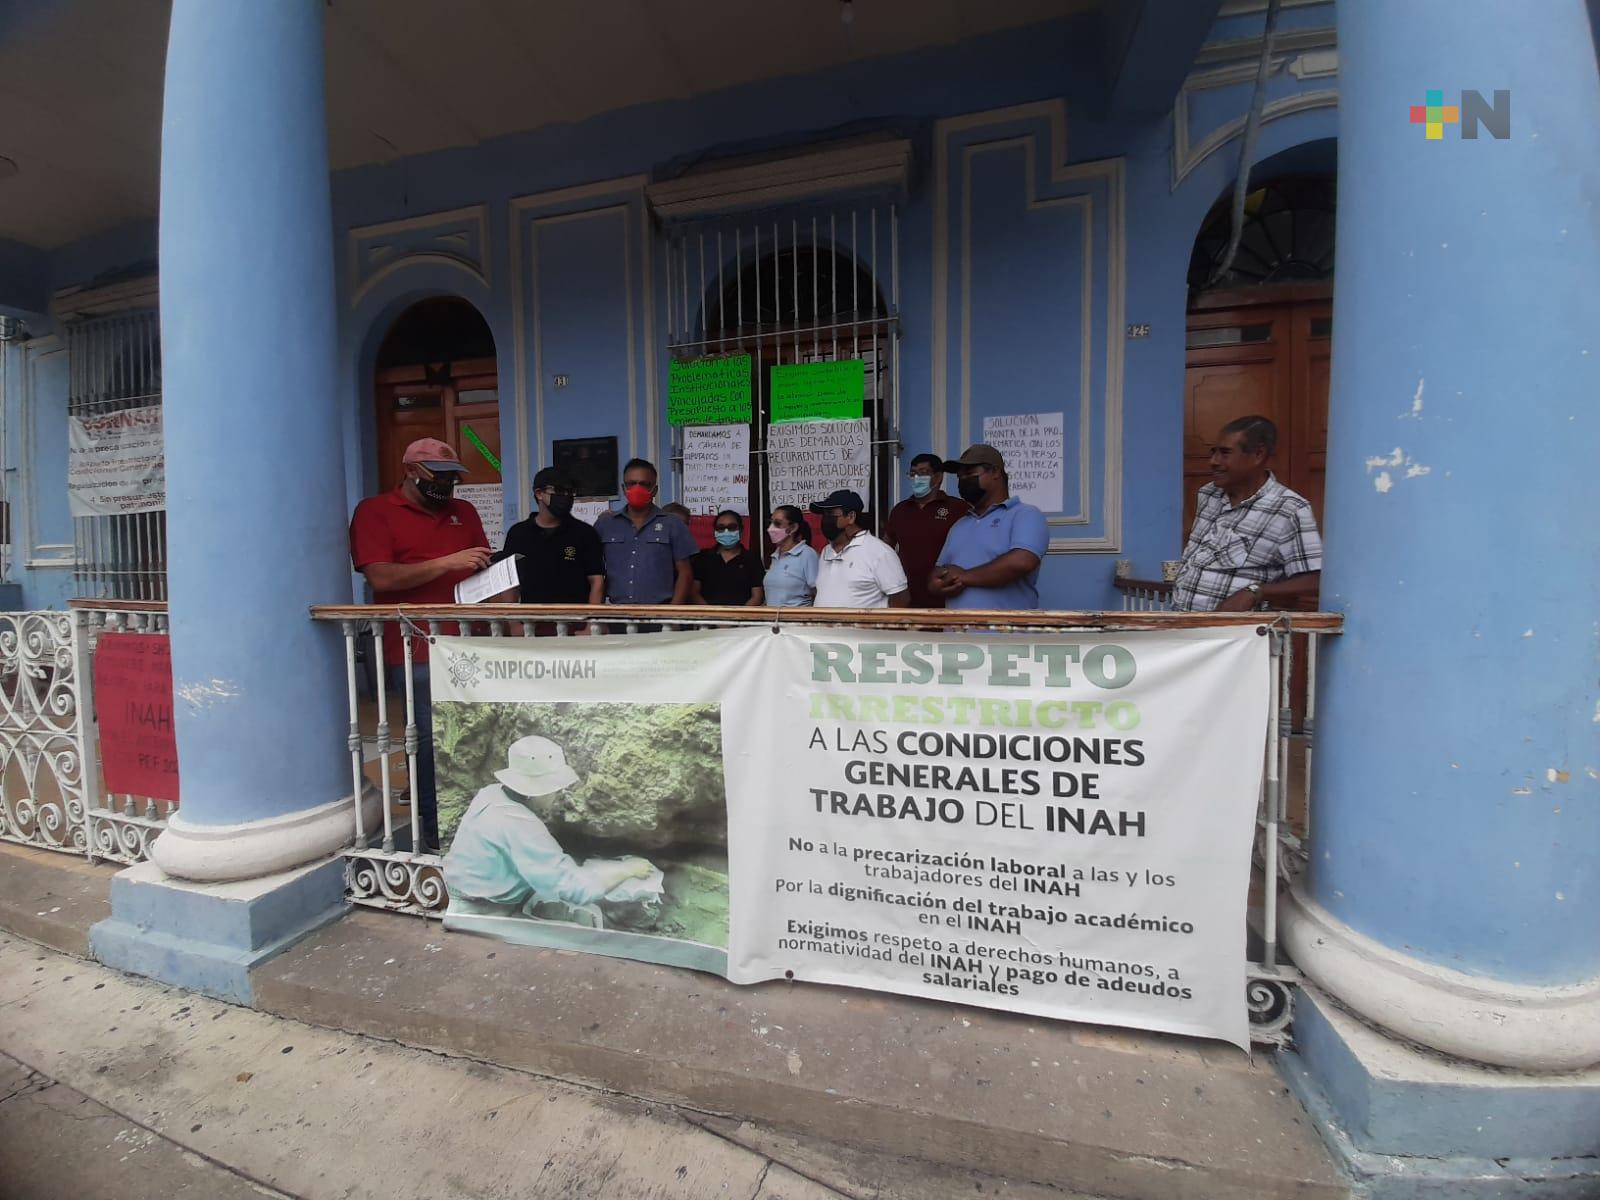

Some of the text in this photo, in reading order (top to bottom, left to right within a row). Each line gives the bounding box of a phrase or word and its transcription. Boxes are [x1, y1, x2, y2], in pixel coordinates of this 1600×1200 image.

[800, 435, 864, 447] DEMANDAS
[791, 480, 815, 491] INAH
[484, 659, 597, 681] SNPICD-INAH
[809, 642, 1137, 690] RESPETO
[126, 702, 171, 735] INAH
[809, 692, 1142, 731] IRRESTRICTO
[809, 727, 1145, 767] A LAS CONDICIONES
[844, 760, 1100, 800] GENERALES DE
[809, 788, 1146, 838] TRABAJO DEL INAH
[789, 837, 1176, 887] No a la precarización laboral a las y los
[864, 863, 1081, 897] trabajadores del INAH
[775, 878, 1194, 934] Por la dignificación del trabajo académico
[918, 913, 1022, 935] en el INAH
[778, 938, 1193, 1000] normatividad del INAH y pago de adeudos
[787, 919, 1180, 980] Exigimos respeto a derechos humanos, a
[922, 972, 1020, 996] salariales
